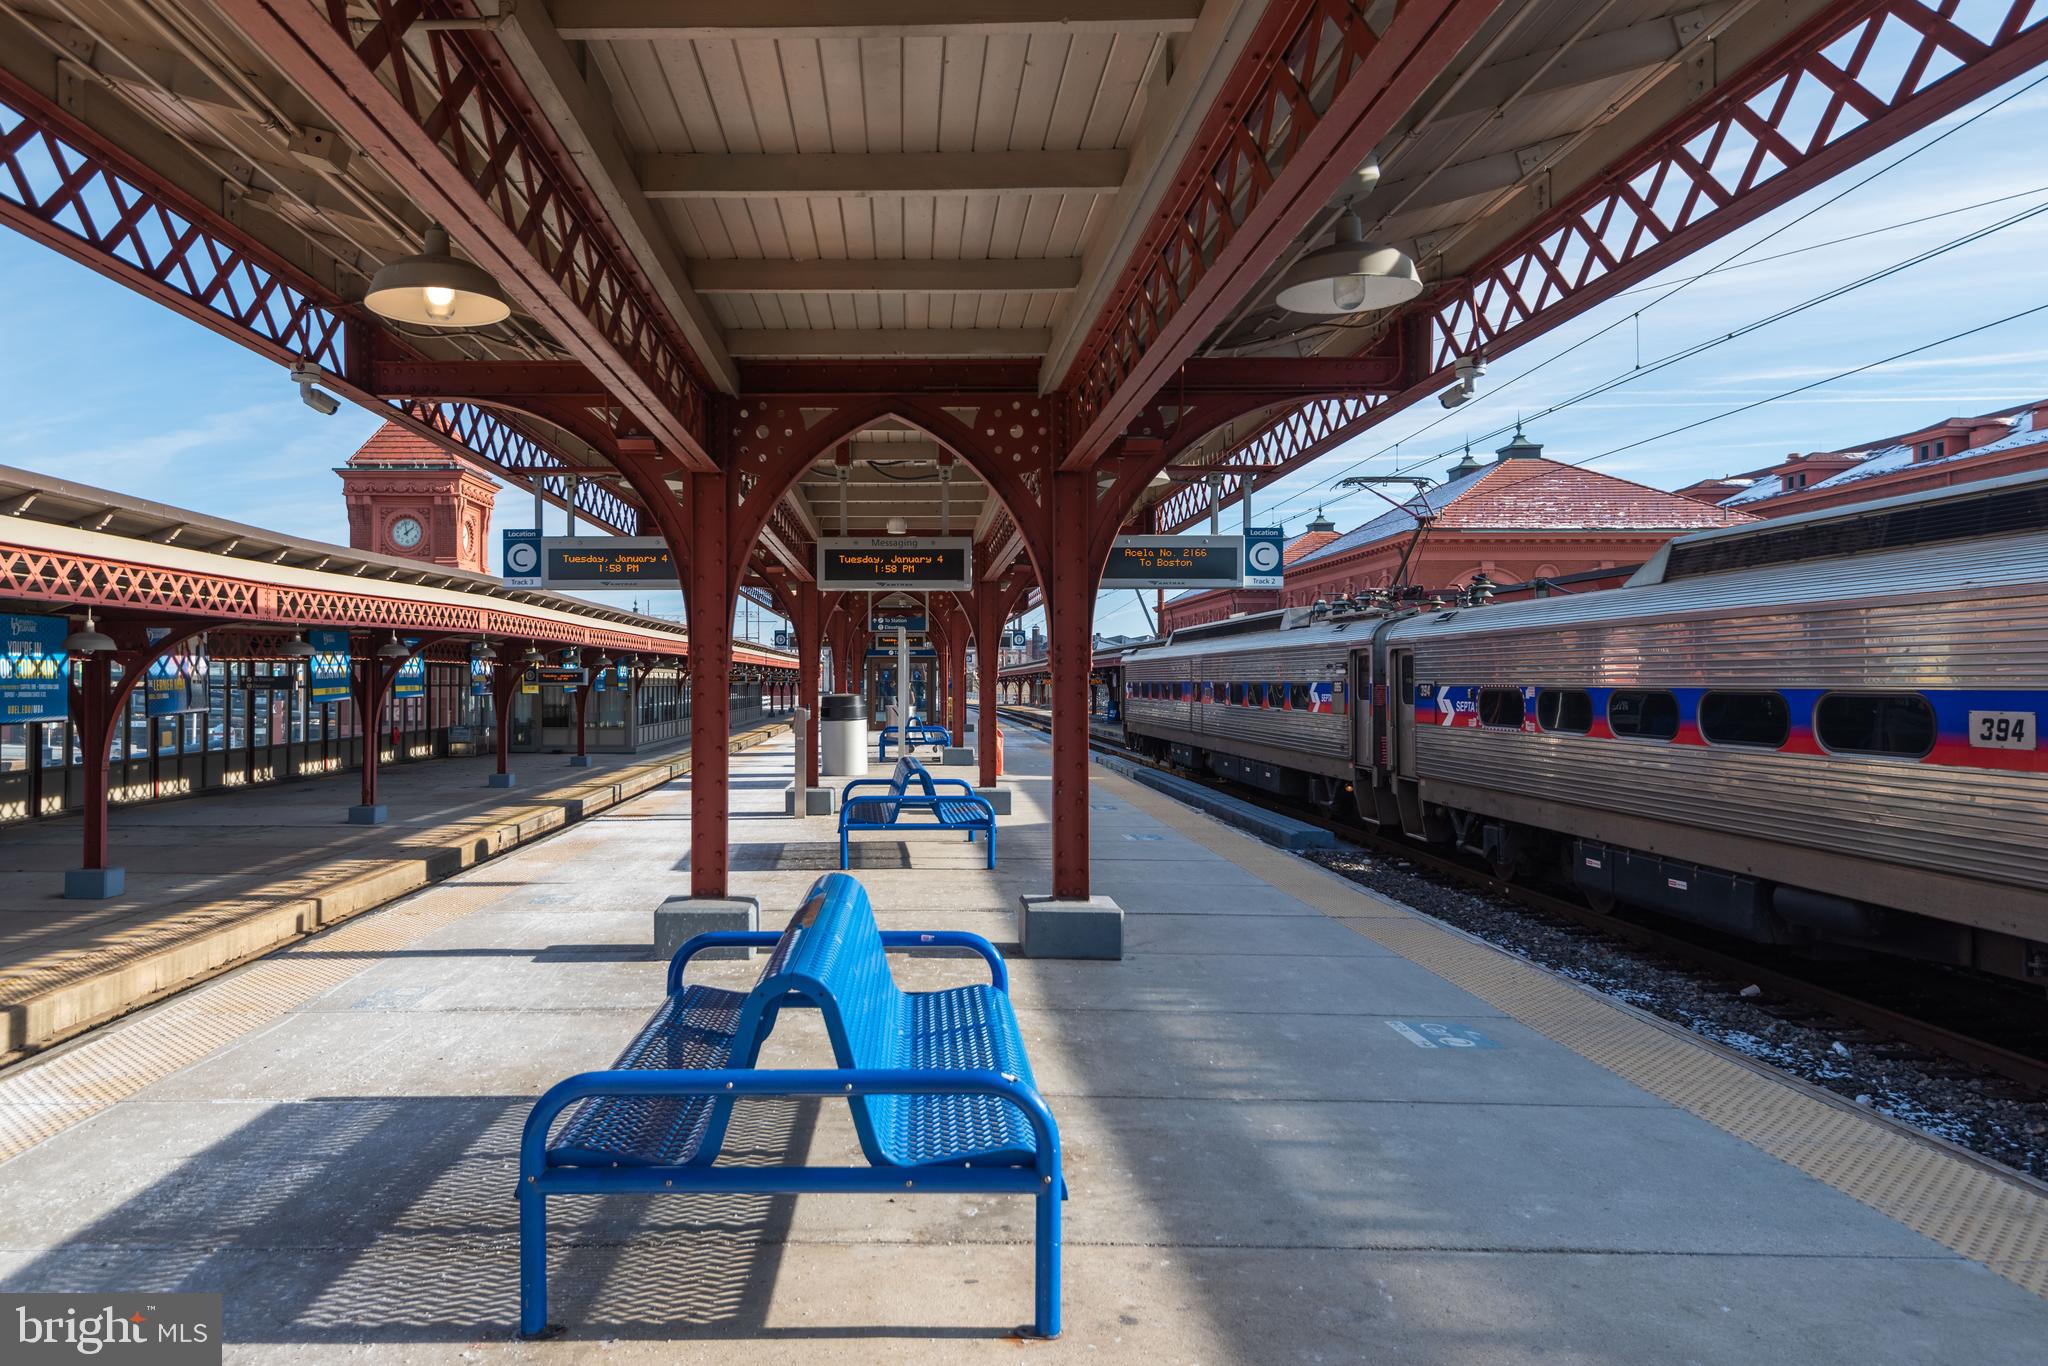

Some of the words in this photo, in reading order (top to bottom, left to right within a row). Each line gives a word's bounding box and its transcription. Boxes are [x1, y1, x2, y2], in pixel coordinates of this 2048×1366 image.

[1250, 529, 1279, 537] Location
[871, 539, 918, 548] Messaging
[1124, 549, 1154, 557] Acela
[1159, 549, 1176, 557] No.
[1183, 549, 1207, 557] 2166
[1255, 547, 1270, 566] C
[513, 549, 528, 567] C
[562, 554, 608, 563] Tuesday,
[615, 554, 657, 563] January
[661, 554, 668, 563] 4
[838, 555, 884, 564] Tuesday,
[890, 555, 932, 564] January
[936, 555, 943, 563] 4
[1139, 558, 1152, 567] To
[1156, 558, 1193, 567] Boston
[599, 564, 622, 573] 1:58
[626, 564, 639, 573] PM
[874, 565, 897, 573] 1:58
[902, 565, 915, 573] PM
[8, 640, 32, 657] YOU'RE
[34, 641, 42, 657] IN
[15, 658, 59, 679] COMPANY
[1420, 685, 1431, 697] 394
[1456, 701, 1475, 713] SEPTA
[1981, 718, 2025, 742] 394
